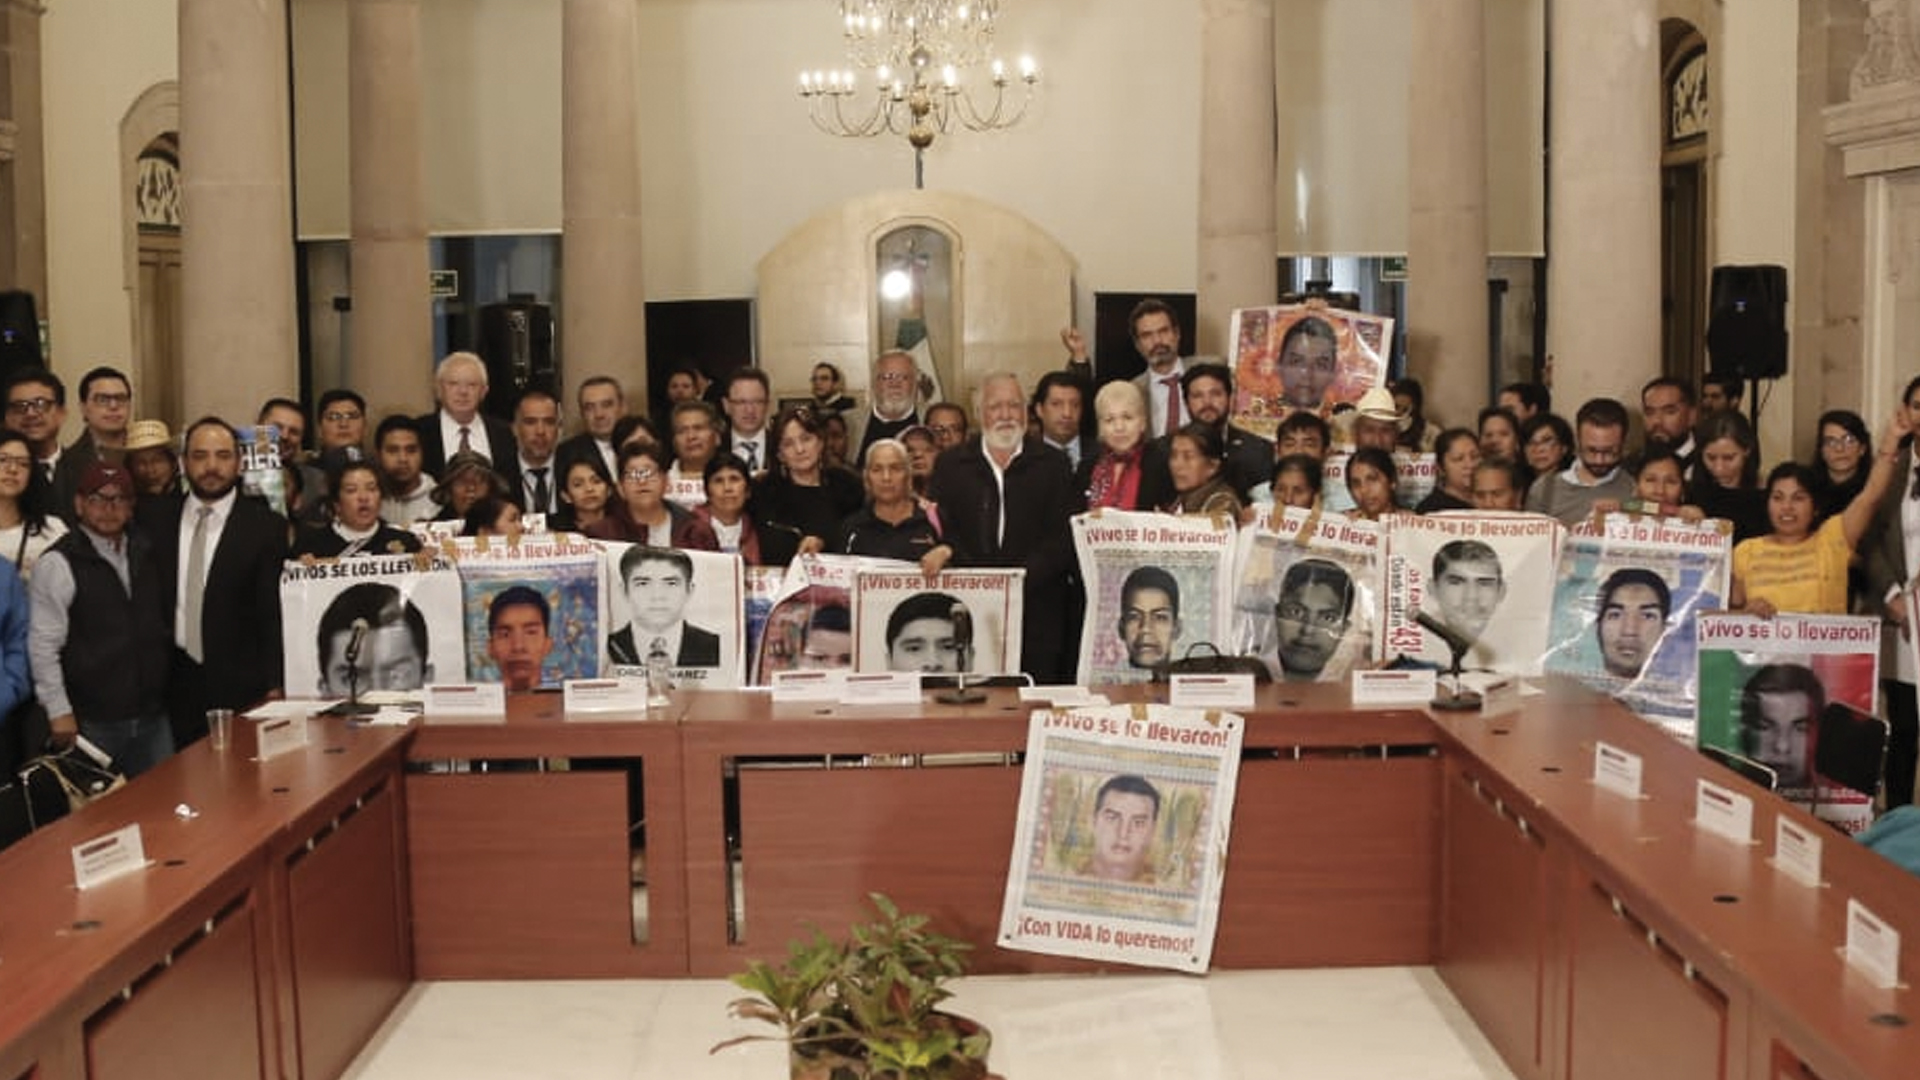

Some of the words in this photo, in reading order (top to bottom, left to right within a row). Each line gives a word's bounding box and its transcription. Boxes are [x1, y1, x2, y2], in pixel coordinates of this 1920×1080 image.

[1086, 527, 1122, 545] ¡Vivo
[1125, 528, 1139, 542] se
[1143, 527, 1157, 543] lo
[1159, 528, 1229, 546] llevaron!
[1321, 523, 1337, 540] lo
[1439, 521, 1457, 535] se
[1461, 521, 1476, 535] lo
[1632, 524, 1648, 541] lo
[330, 563, 350, 577] SE
[352, 561, 378, 577] LOS
[380, 558, 450, 576] LLEVON
[861, 573, 901, 591] ¡Vivo
[905, 577, 921, 590] se
[925, 575, 938, 590] lo
[942, 574, 1005, 590] llevaron!
[1748, 622, 1770, 639] se
[1776, 619, 1793, 640] lo
[1099, 718, 1119, 736] se
[1125, 718, 1142, 738] lo
[1147, 721, 1230, 748] llevaron!
[1017, 916, 1052, 937] ¡Con
[1056, 920, 1093, 941] VIDA
[1096, 926, 1111, 944] lo
[1114, 930, 1196, 955] queremos!
